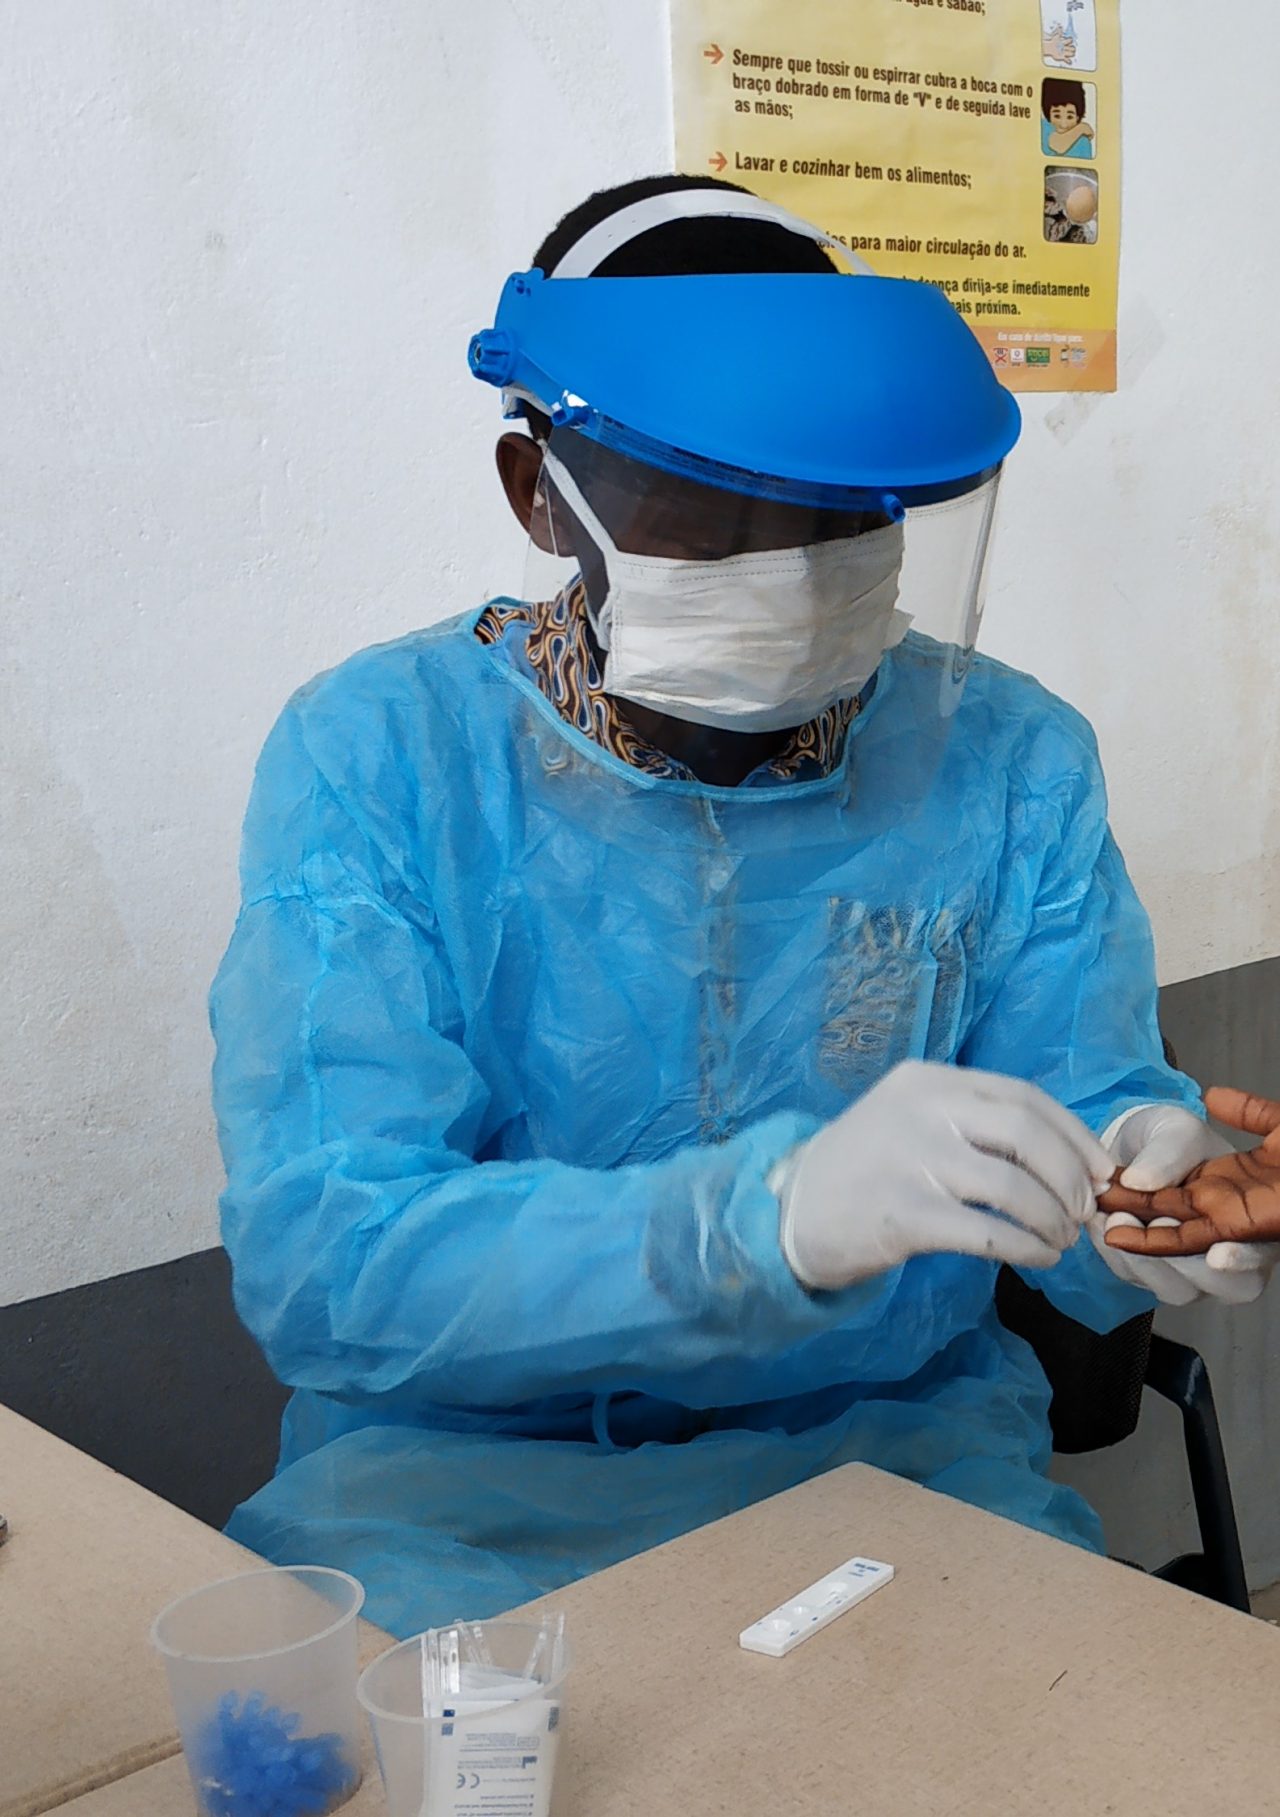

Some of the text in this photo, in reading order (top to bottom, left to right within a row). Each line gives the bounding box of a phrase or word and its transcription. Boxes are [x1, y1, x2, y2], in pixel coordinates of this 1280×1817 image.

[733, 49, 1033, 98] Sempre que tossir ou espirrar cubra a boca com o
[733, 72, 1031, 119] braço dobrado em forma de "V" e de seguida lave
[735, 100, 793, 120] as mãos;
[735, 151, 972, 189] Lavar e cozinhar bem os alimentos;
[851, 236, 881, 251] para
[886, 236, 922, 253] maior
[926, 237, 991, 260] circulação
[994, 241, 1009, 257] do
[1012, 245, 1027, 258] ar.
[962, 277, 1008, 296] dirija-se
[1012, 279, 1090, 298] imediatamente
[951, 299, 1021, 317] ais próxima.
